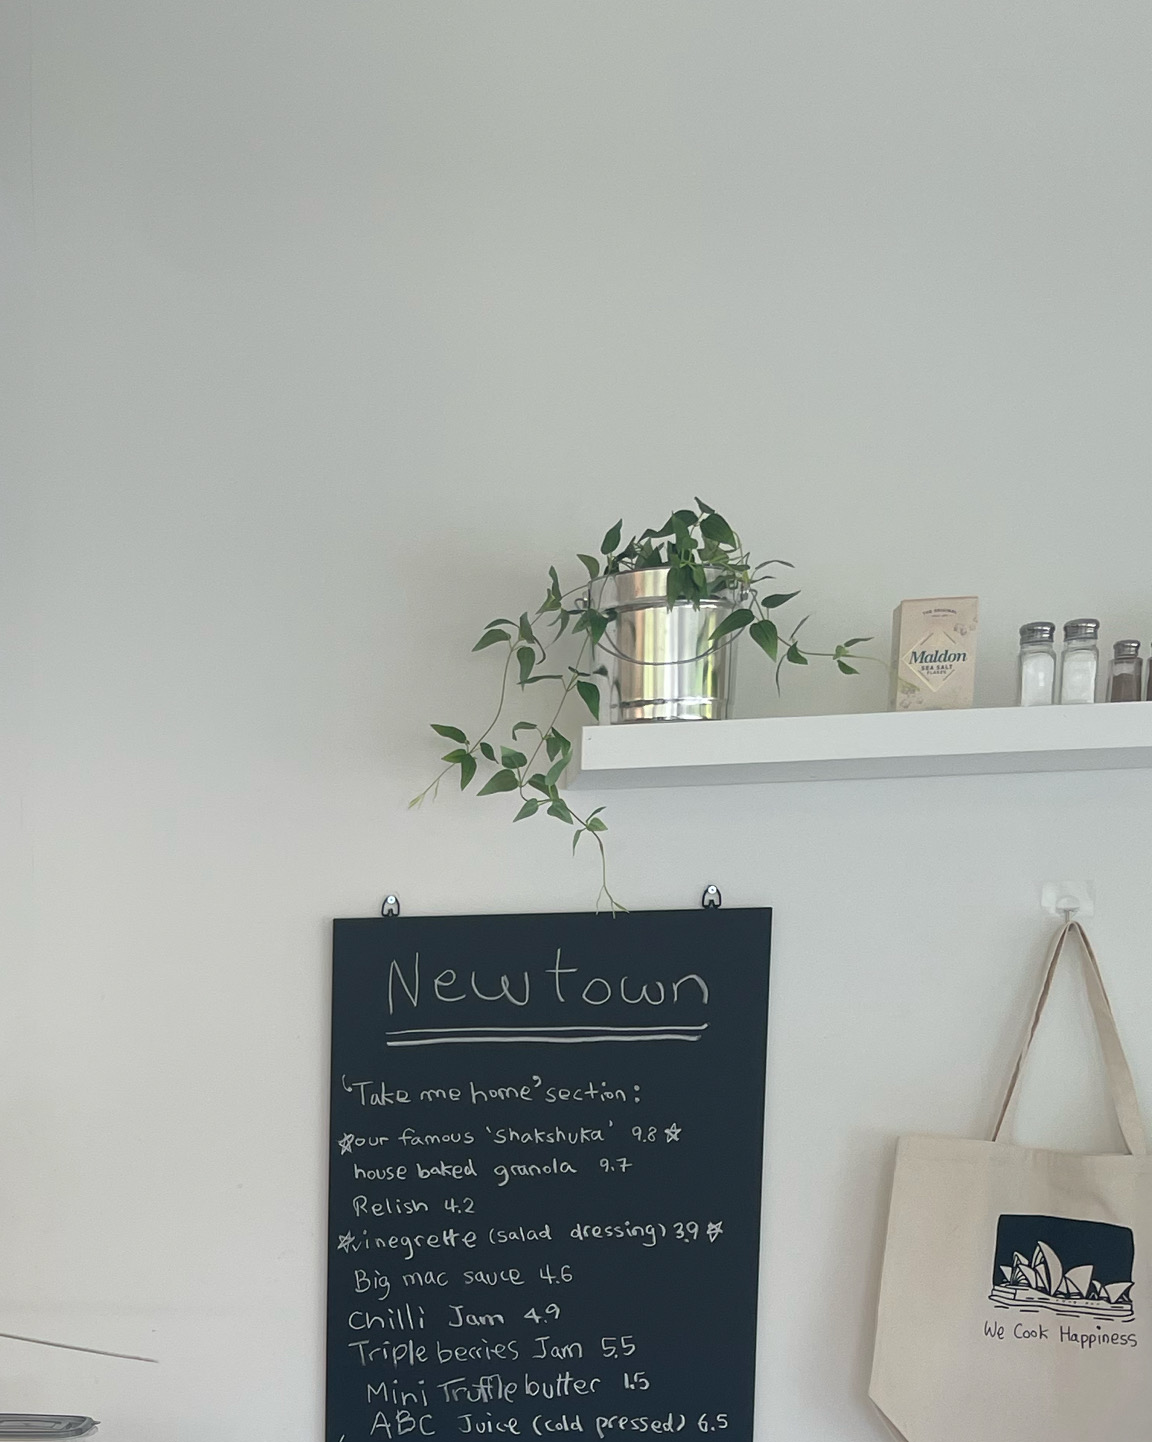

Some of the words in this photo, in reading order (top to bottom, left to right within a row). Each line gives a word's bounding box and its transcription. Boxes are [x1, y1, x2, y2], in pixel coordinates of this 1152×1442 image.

[908, 649, 968, 665] Maldon
[389, 948, 708, 1014] Newtown
[421, 1089, 460, 1101] me
[546, 1082, 640, 1102] section:
[354, 1135, 390, 1147] our
[398, 1128, 474, 1145] famous
[632, 1126, 657, 1142] 9.8
[354, 1164, 407, 1180] house
[416, 1159, 477, 1179] baked
[494, 1158, 577, 1186] granola
[600, 1158, 632, 1172] 9.7
[353, 1195, 428, 1216] Relish
[445, 1198, 474, 1213] 4.2
[351, 1229, 476, 1260] vinegrette
[490, 1225, 552, 1244] (salad
[571, 1221, 666, 1246] dressing)
[673, 1222, 698, 1242] 3.9
[355, 1270, 390, 1300] Big
[403, 1272, 448, 1286] mac
[464, 1269, 524, 1285] sauce
[540, 1264, 572, 1284] 4.6
[349, 1304, 424, 1329] Chilli
[449, 1305, 504, 1327] Jam
[524, 1304, 560, 1323] 4.9
[984, 1321, 1005, 1340] We
[1013, 1323, 1049, 1340] Cook
[1060, 1325, 1138, 1349] Happiness
[348, 1340, 427, 1365] Triple
[437, 1339, 518, 1363] berries
[533, 1336, 582, 1359] Jam
[602, 1336, 635, 1358] 5.5
[368, 1380, 427, 1406] Mini
[437, 1374, 517, 1402] Truffle
[525, 1372, 600, 1398] butter
[624, 1372, 649, 1389] 1.5
[370, 1410, 435, 1438] ABC
[458, 1413, 520, 1434] Juice
[533, 1415, 583, 1435] (cold
[596, 1413, 685, 1438] pressed)
[698, 1414, 727, 1432] 6.5
